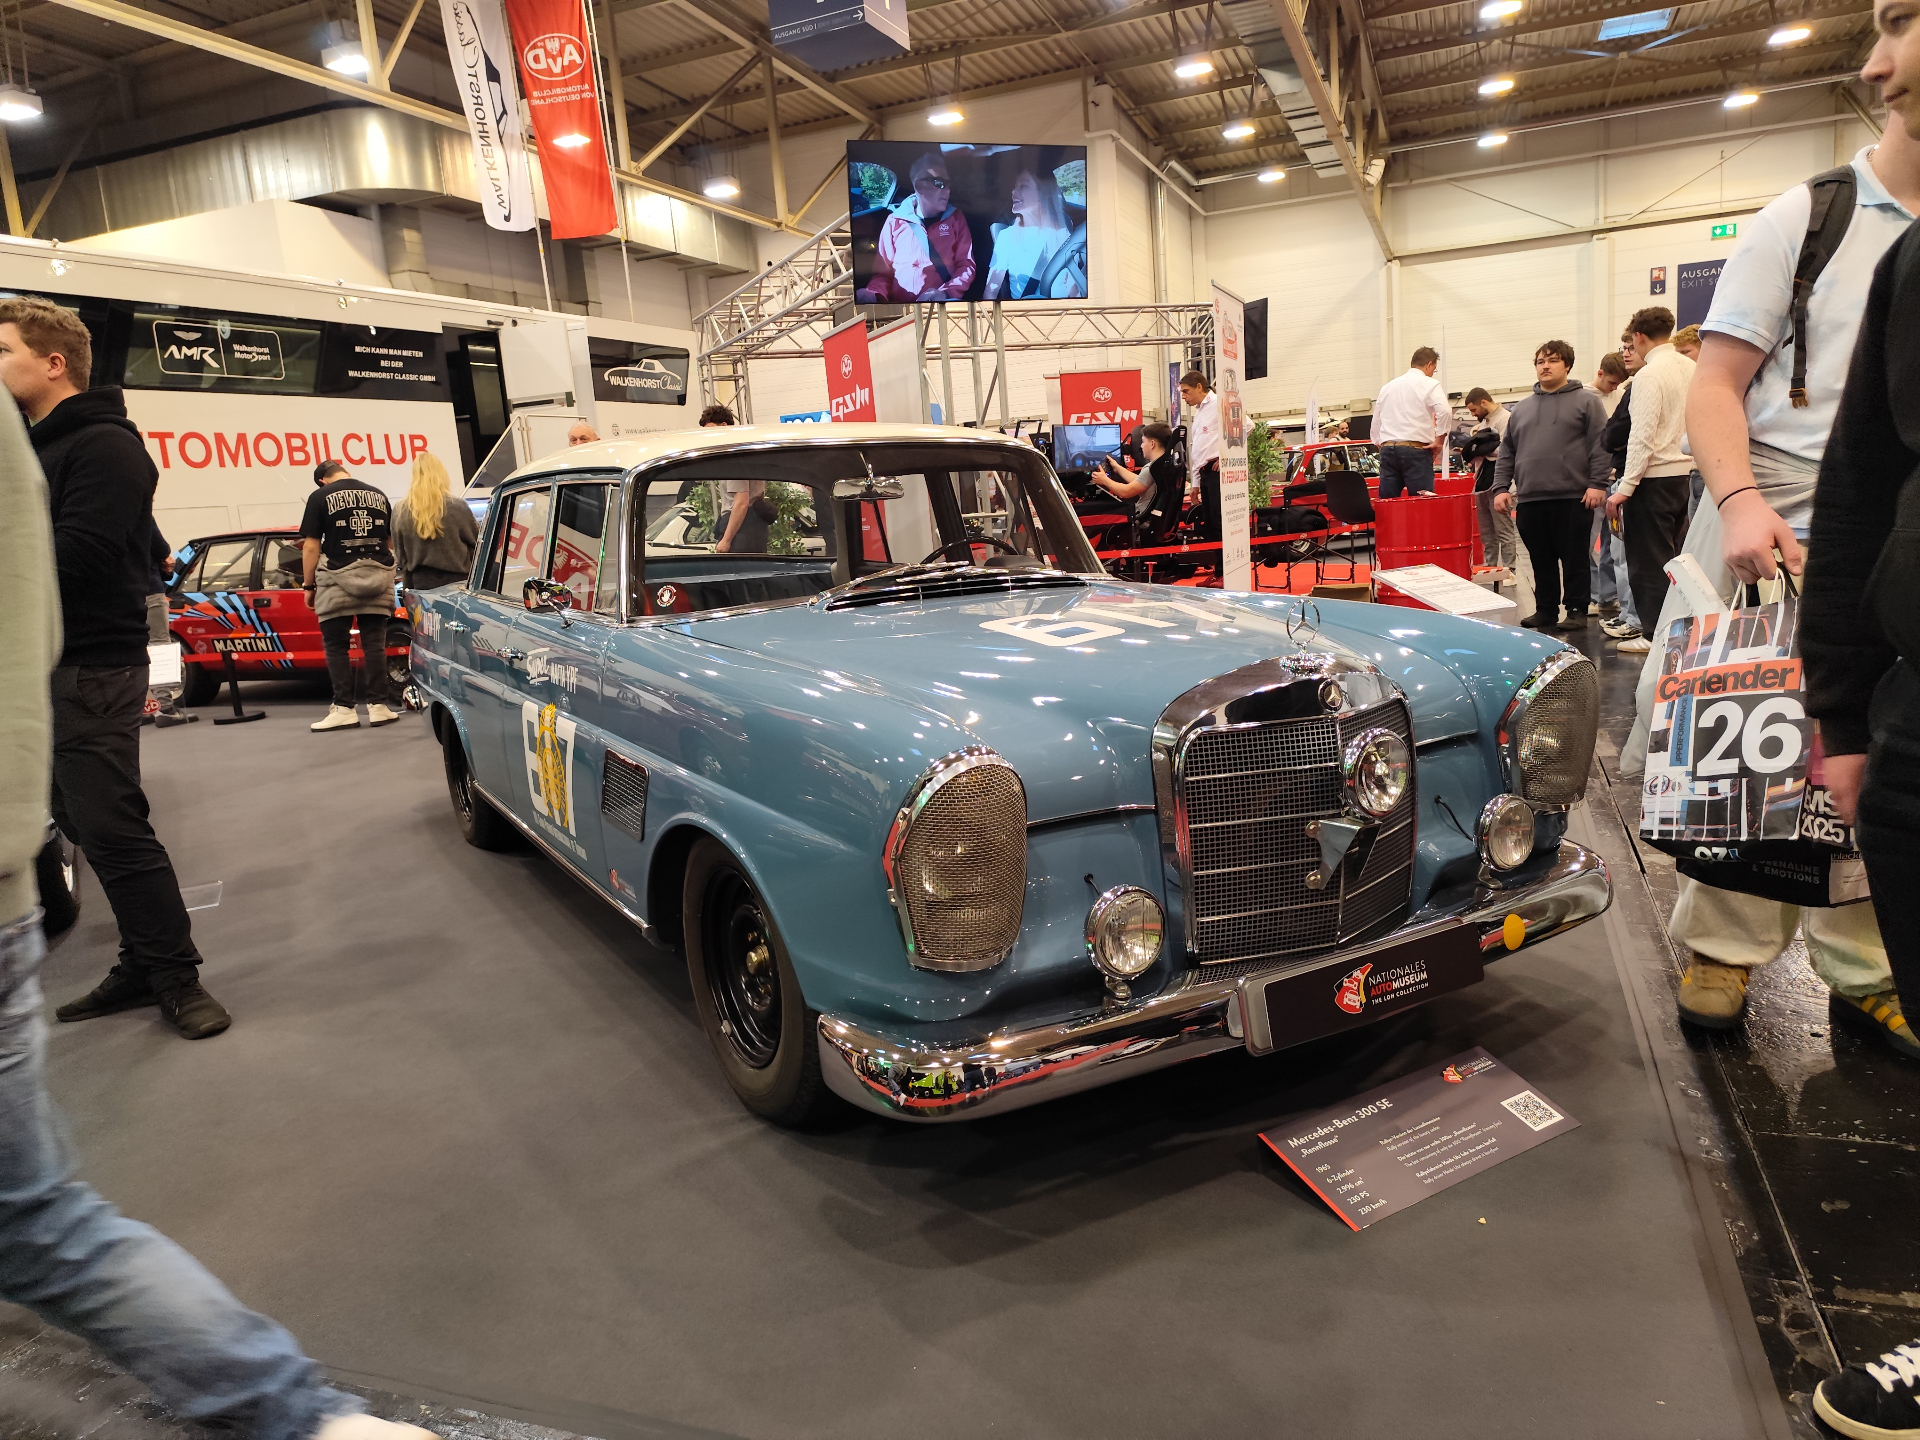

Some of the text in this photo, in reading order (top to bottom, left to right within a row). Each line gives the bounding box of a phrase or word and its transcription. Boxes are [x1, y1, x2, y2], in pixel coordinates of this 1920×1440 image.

[774, 26, 801, 39] AUSGANG
[802, 24, 814, 33] SÜD
[1681, 267, 1722, 279] AUSGAN
[1681, 279, 1704, 289] EXIT
[164, 344, 220, 368] AMR
[232, 344, 270, 353] Walkenhorst
[402, 350, 423, 358] MIETEN
[348, 370, 395, 379] WALKENHORST
[609, 375, 661, 389] WALKENHORST
[140, 431, 429, 469] TOMOBILCLUB
[214, 636, 273, 652] MARTINI
[1659, 663, 1795, 700] Carlender
[1696, 696, 1806, 776] 26
[1764, 865, 1820, 885] EMOTIONS
[1368, 959, 1426, 986] NATIONALES
[1370, 970, 1428, 997] AUTOMUSEUM
[1372, 982, 1429, 1006] THE LOH COLLECTION
[1287, 1098, 1393, 1149] Mercedes-Benz 300 SE
[1326, 1168, 1355, 1184] 6-Zylinder
[1347, 1190, 1370, 1205] 230 PS
[1358, 1198, 1387, 1216] 230 km/h
